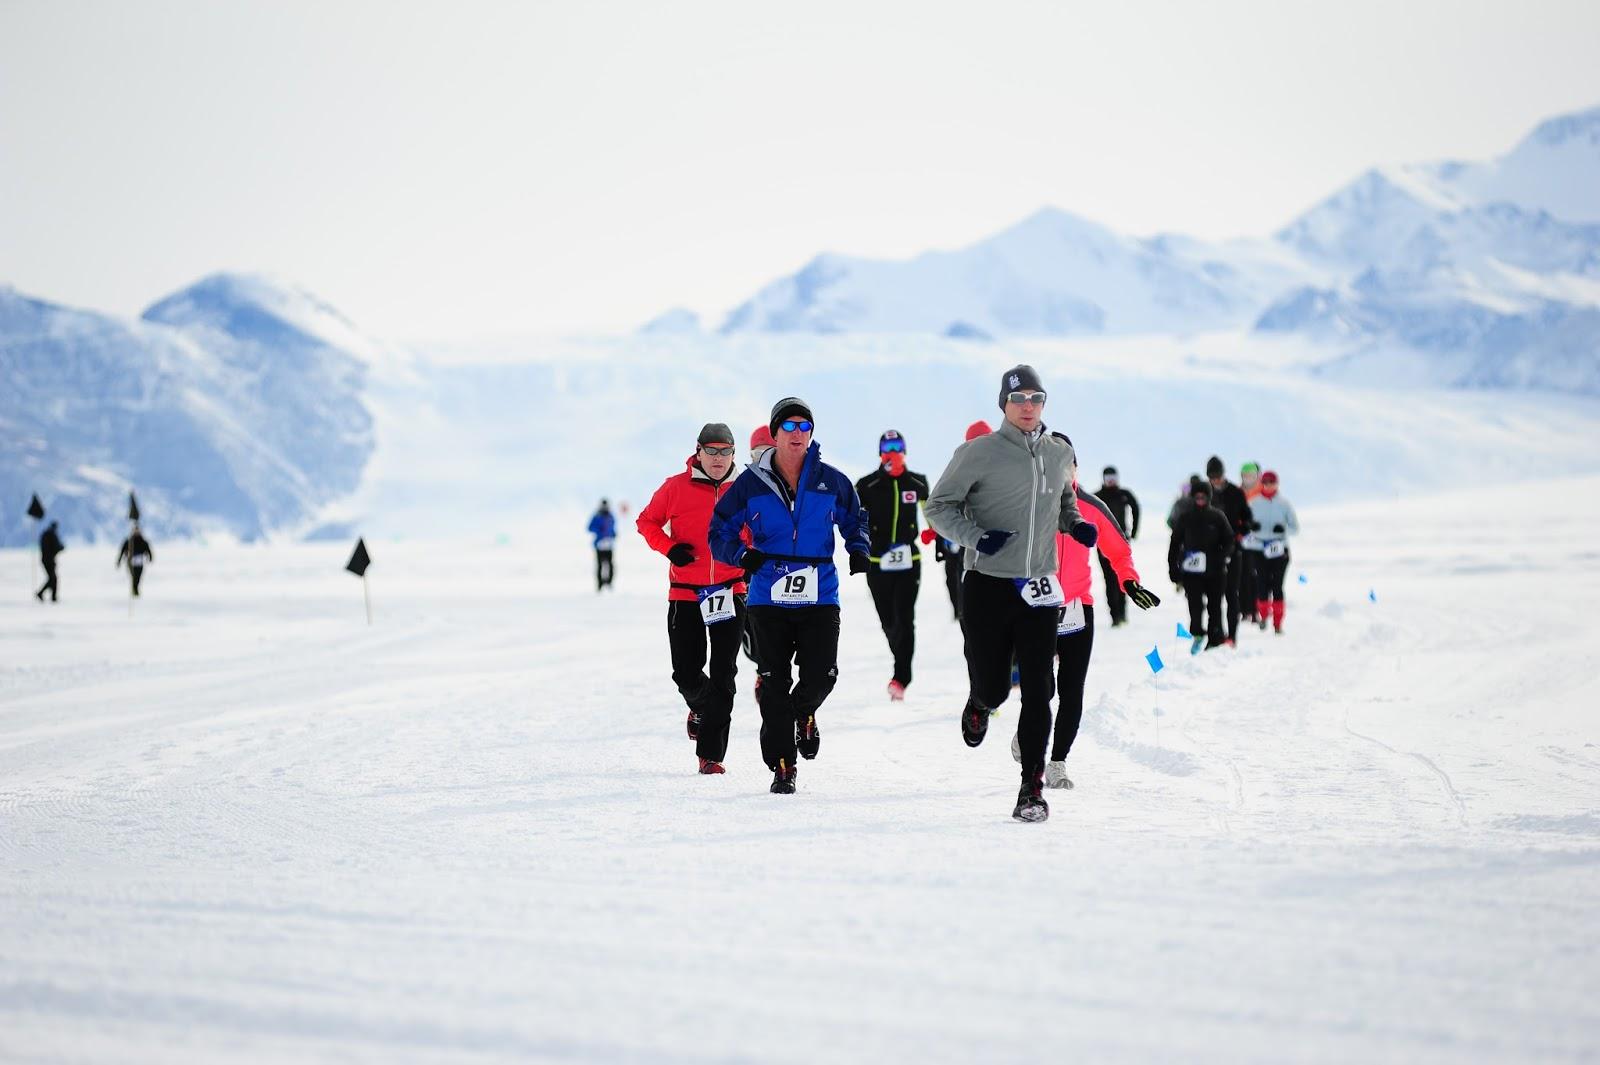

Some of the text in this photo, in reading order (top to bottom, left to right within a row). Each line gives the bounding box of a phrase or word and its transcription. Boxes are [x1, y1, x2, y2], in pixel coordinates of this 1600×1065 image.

[889, 551, 904, 563] 33
[784, 575, 806, 593] 19
[1028, 576, 1052, 599] 38
[707, 595, 725, 613] 17
